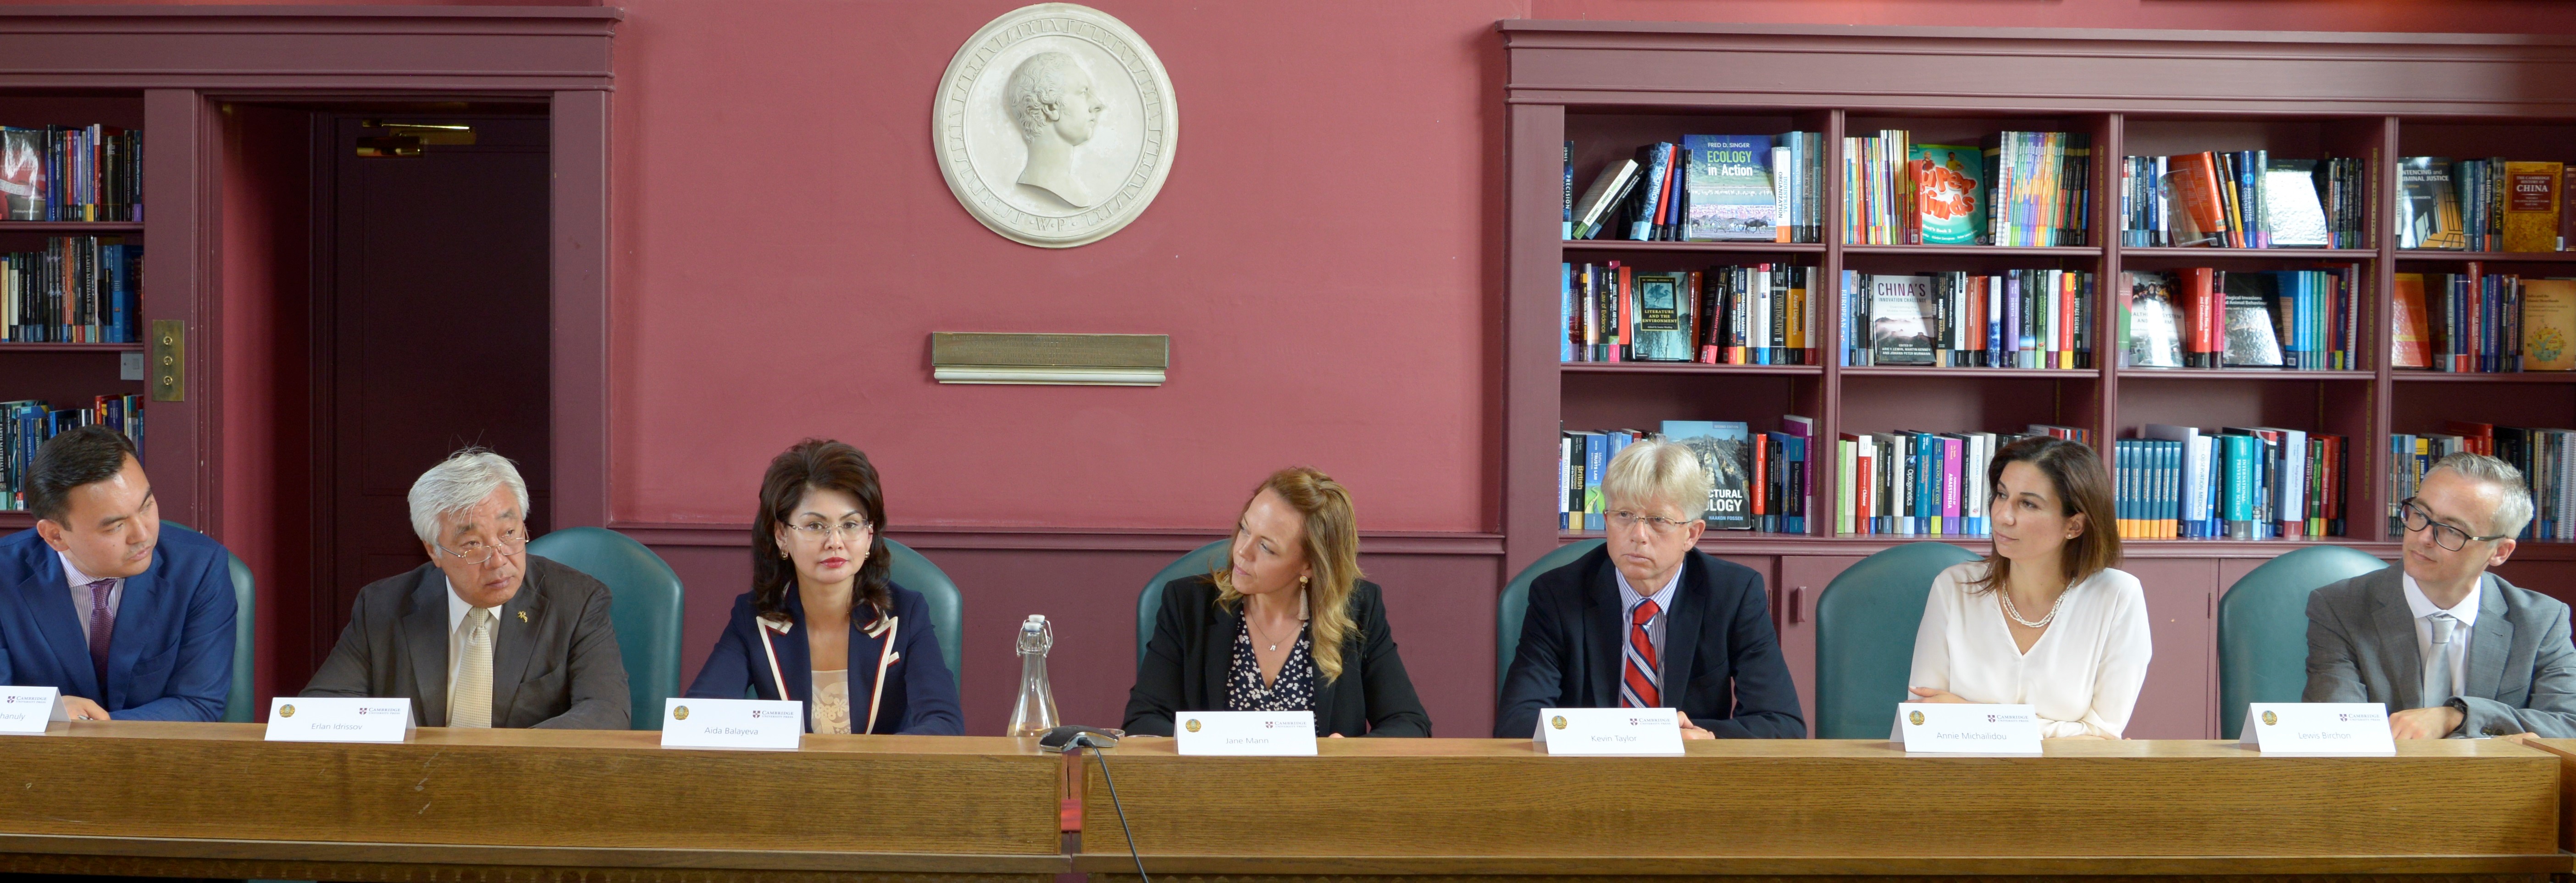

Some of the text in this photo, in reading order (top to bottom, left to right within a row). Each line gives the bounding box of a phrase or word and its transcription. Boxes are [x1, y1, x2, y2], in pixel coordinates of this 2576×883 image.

[1707, 151, 1752, 163] ECOLOGY
[1708, 164, 1753, 176] in Action
[1650, 167, 1665, 204] Cognition
[1878, 283, 1926, 296] CHINA'S
[1775, 295, 1783, 335] COMETOGRAPHY
[1708, 489, 1742, 498] CTURAL
[726, 728, 758, 736] Balayeva
